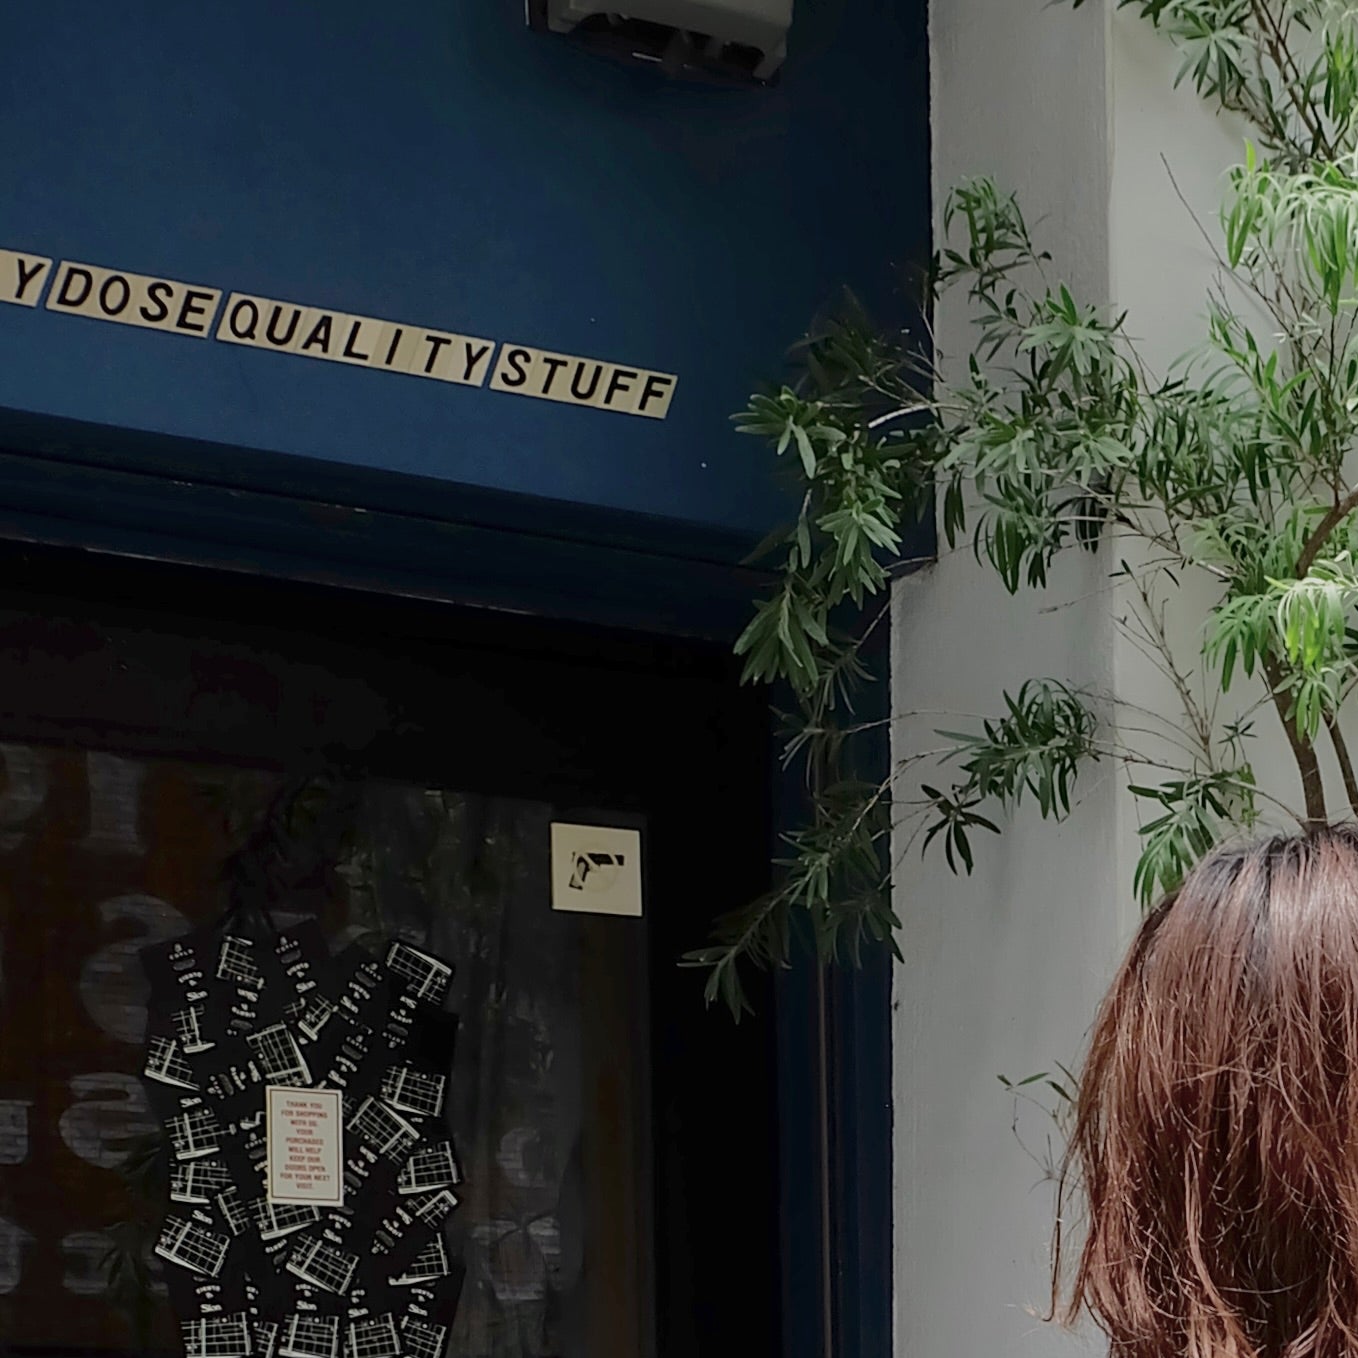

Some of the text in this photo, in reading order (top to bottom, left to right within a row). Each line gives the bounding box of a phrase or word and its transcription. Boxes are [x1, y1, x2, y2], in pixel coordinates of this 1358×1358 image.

[14, 257, 672, 412] Y DOSE QUALITY STUFF
